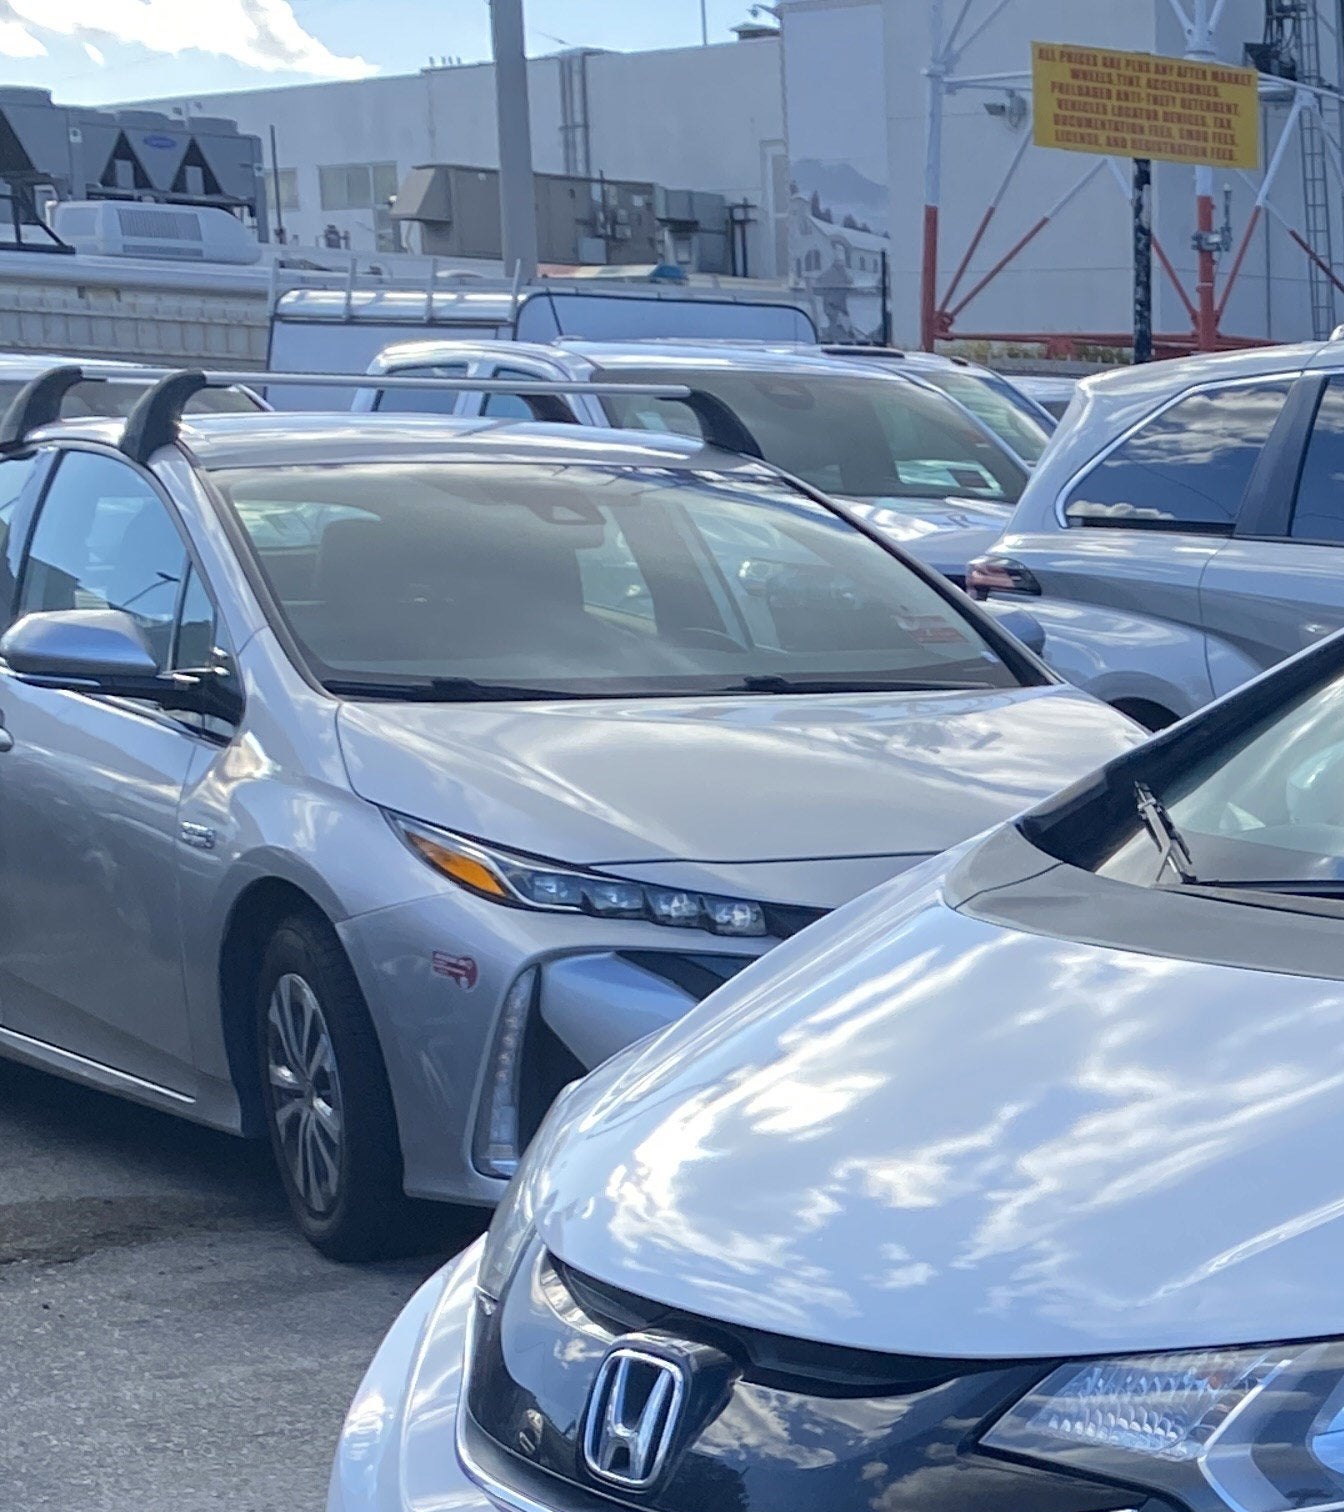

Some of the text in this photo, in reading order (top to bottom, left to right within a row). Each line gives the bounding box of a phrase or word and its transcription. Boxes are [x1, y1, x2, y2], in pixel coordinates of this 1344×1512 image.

[1059, 50, 1098, 67] PRICES
[1125, 58, 1150, 74] PLUS
[1154, 62, 1174, 76] ANY
[1176, 65, 1207, 80] AFTER
[1210, 70, 1252, 86] MARKET
